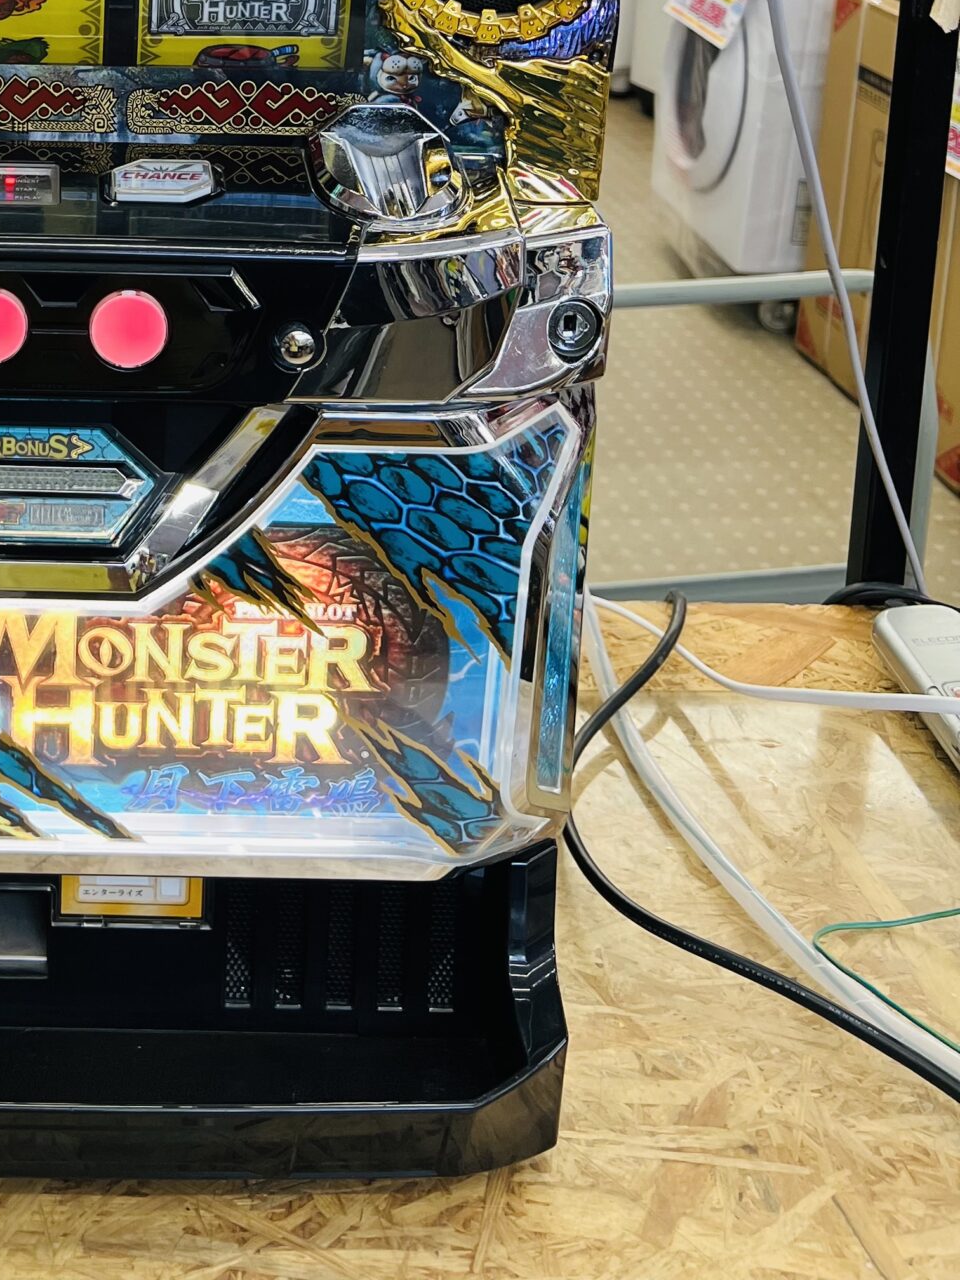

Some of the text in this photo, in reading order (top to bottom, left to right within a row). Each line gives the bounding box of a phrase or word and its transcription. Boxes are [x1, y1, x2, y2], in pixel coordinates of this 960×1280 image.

[201, 0, 292, 24] HUNTER
[121, 172, 202, 181] CHANCE
[0, 675, 352, 767] HUNTER
[82, 888, 144, 897] エンターライズ
